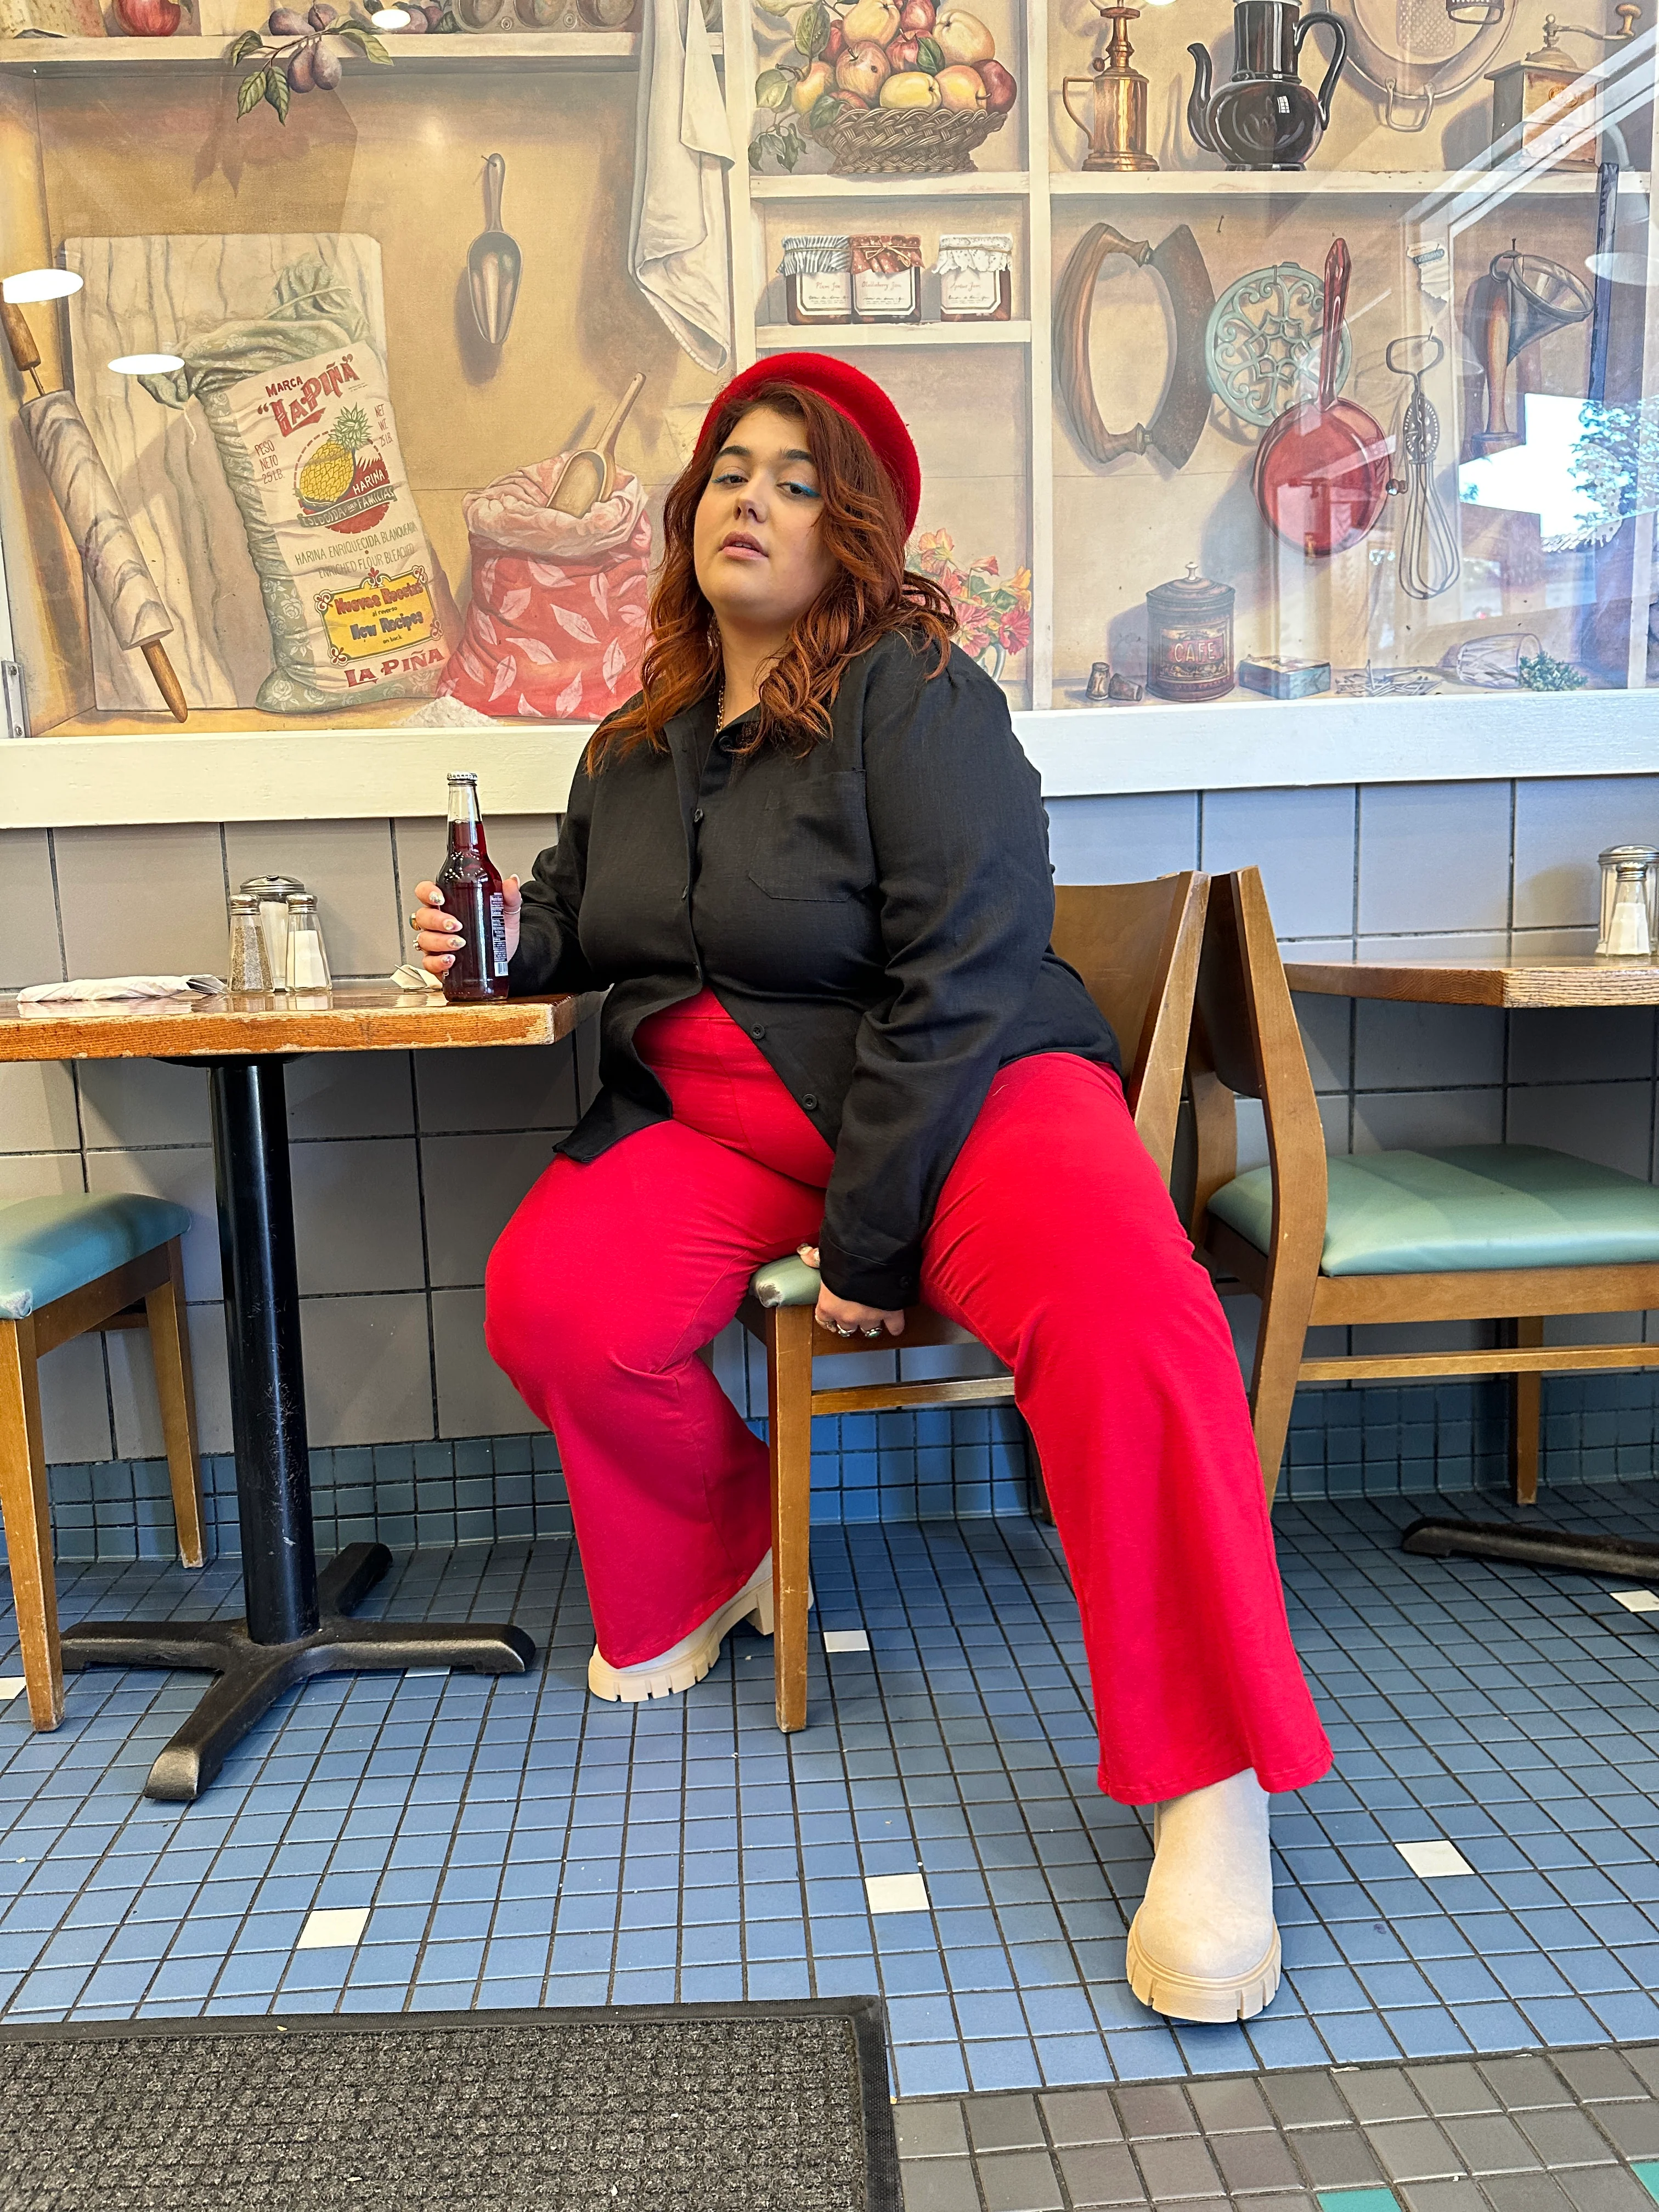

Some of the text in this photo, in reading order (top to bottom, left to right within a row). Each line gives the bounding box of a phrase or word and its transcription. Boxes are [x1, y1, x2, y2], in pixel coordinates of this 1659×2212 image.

[266, 376, 303, 397] MARCA
[374, 404, 385, 417] NET
[255, 439, 275, 456] PESO
[259, 454, 279, 471] NETO
[262, 473, 273, 484] 25
[352, 469, 385, 495] HARINA
[358, 487, 394, 510] FAMILIAS
[295, 520, 419, 566] HARINA ENRIQUECIDA BLANQUEADA
[318, 543, 415, 579] ENRICHED FLOUR BLEACHED
[334, 582, 424, 615] Nuevas Recetas
[378, 606, 397, 615] reverso
[350, 611, 424, 640] New Recipes
[390, 634, 403, 642] back
[1174, 642, 1215, 663] CAFE
[344, 648, 445, 687] LA PIÑA
